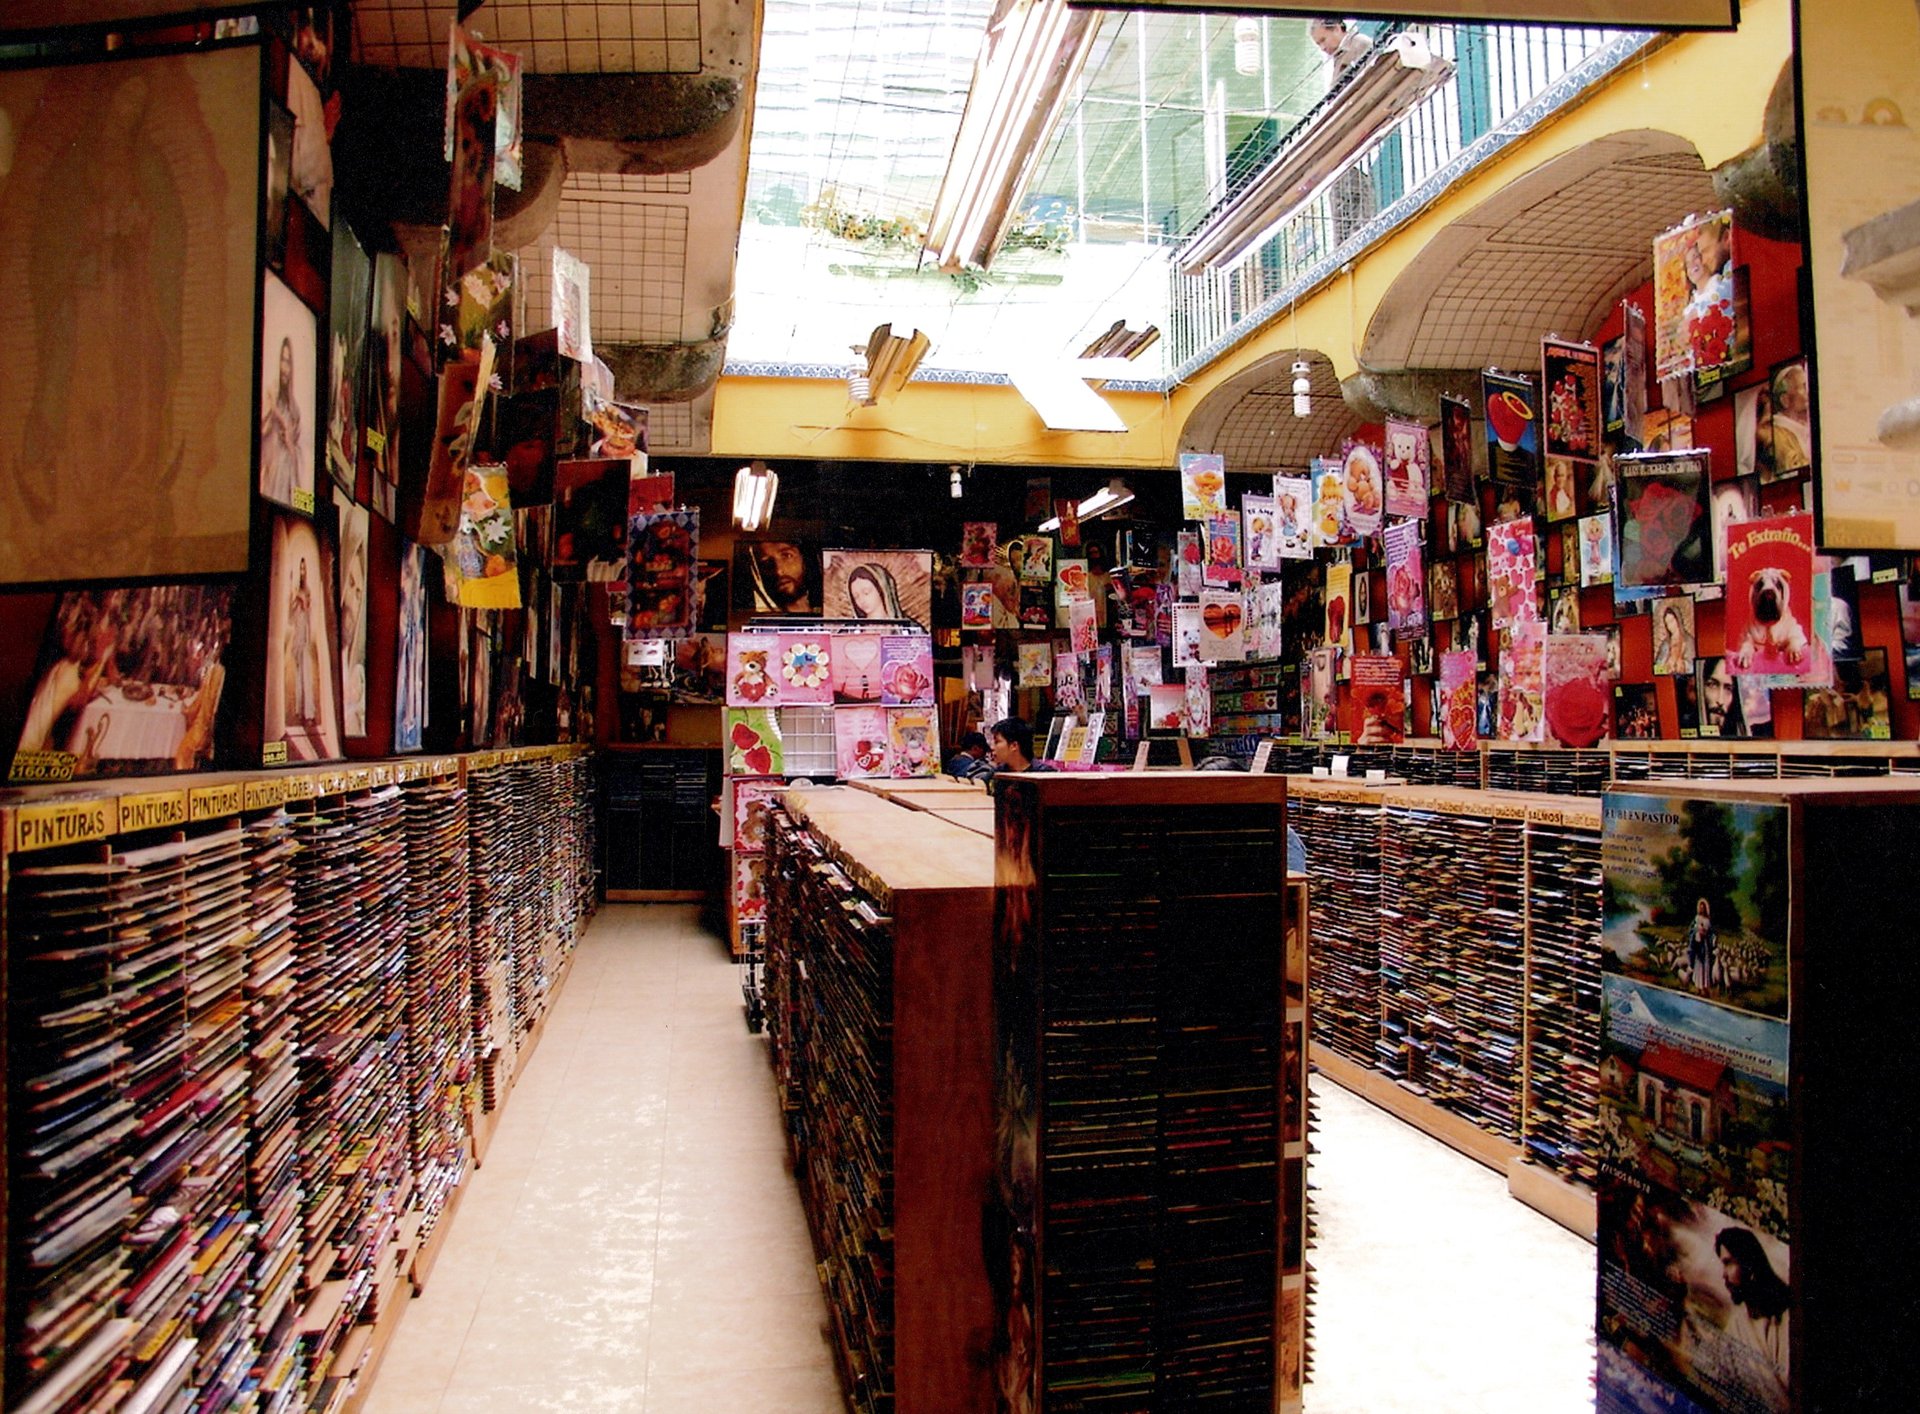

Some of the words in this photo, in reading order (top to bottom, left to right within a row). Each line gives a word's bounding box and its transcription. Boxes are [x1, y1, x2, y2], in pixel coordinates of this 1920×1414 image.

[1728, 541, 1747, 560] Te
[1746, 527, 1811, 553] Extraño...
[192, 793, 239, 817] PINTURAS
[247, 784, 283, 806] PINTURAS
[121, 799, 184, 828] PINTURAS
[1528, 809, 1560, 823] SALMOS
[1641, 811, 1680, 825] PASTOR
[20, 810, 105, 848] PINTURAS
